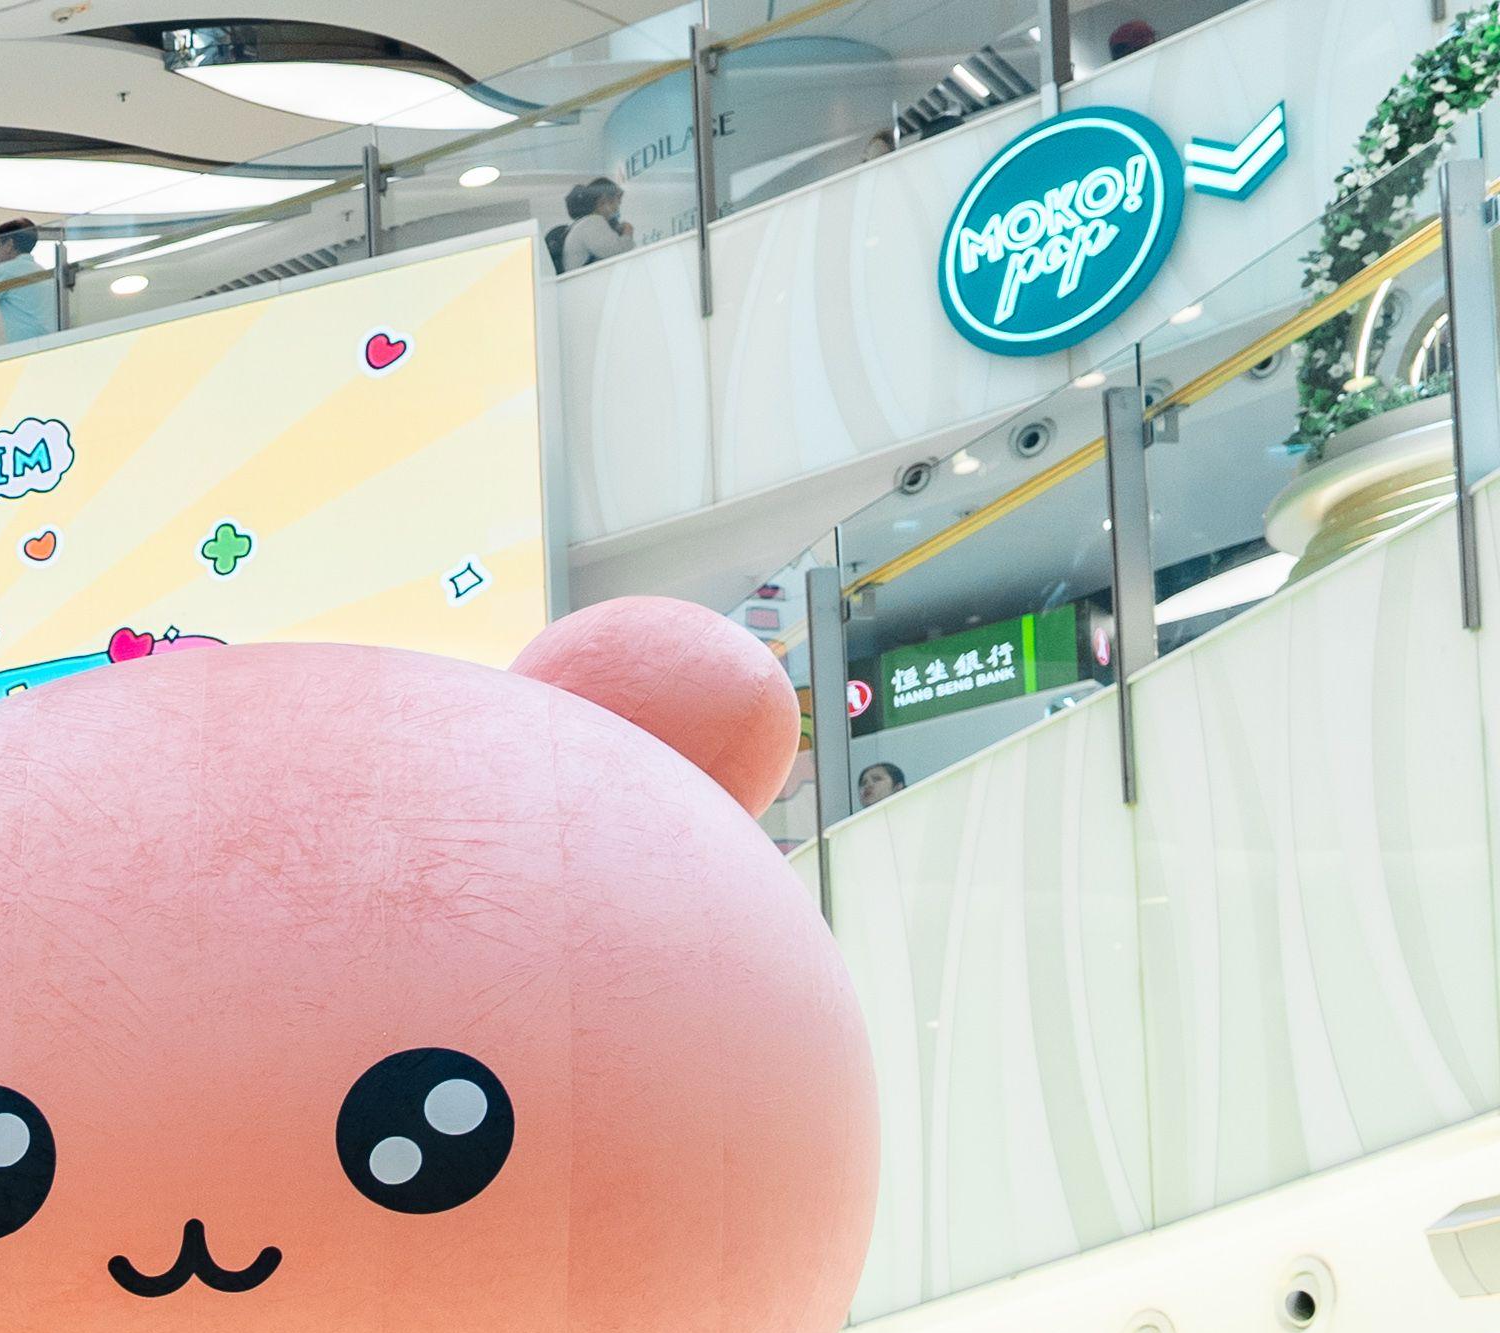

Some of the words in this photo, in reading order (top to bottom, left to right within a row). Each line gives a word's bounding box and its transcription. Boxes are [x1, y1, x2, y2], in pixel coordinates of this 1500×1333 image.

[891, 641, 1015, 695] 恒生銀行
[893, 686, 937, 708] HANG
[936, 678, 974, 698] SENG
[975, 667, 1016, 689] BANK
